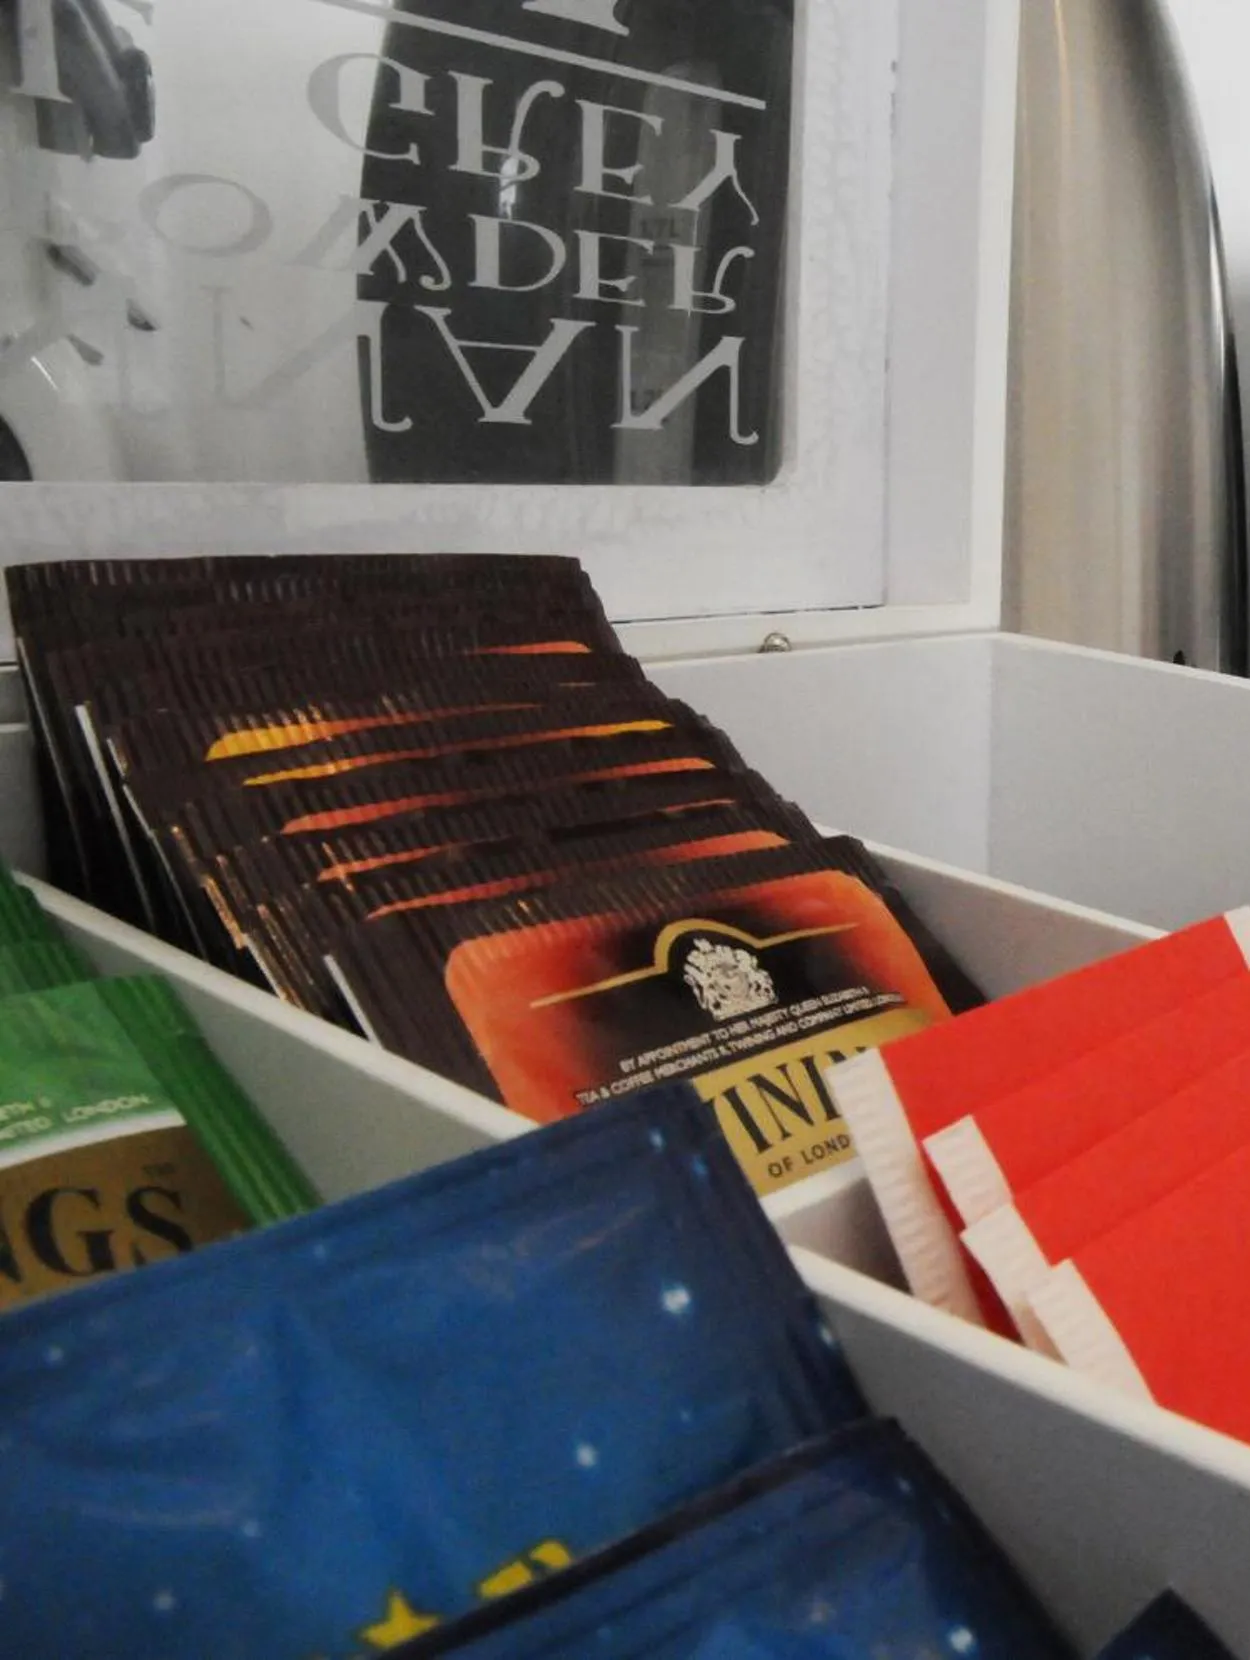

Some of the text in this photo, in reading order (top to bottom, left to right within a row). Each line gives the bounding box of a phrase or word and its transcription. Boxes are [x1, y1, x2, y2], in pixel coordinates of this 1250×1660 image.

[576, 1090, 600, 1106] TEA
[610, 1070, 654, 1095] COFFEE
[654, 1048, 720, 1079] MERCHANTS
[775, 1020, 799, 1037] AND
[798, 1006, 844, 1030] COMPANY
[619, 1058, 636, 1073] BY
[638, 1033, 711, 1067] APPOINTMENT
[711, 1027, 730, 1042] TO
[750, 1007, 790, 1029] MAJESTY
[789, 998, 822, 1017] QUEEN
[702, 1046, 867, 1154] INI
[767, 1132, 851, 1179] OF LOND
